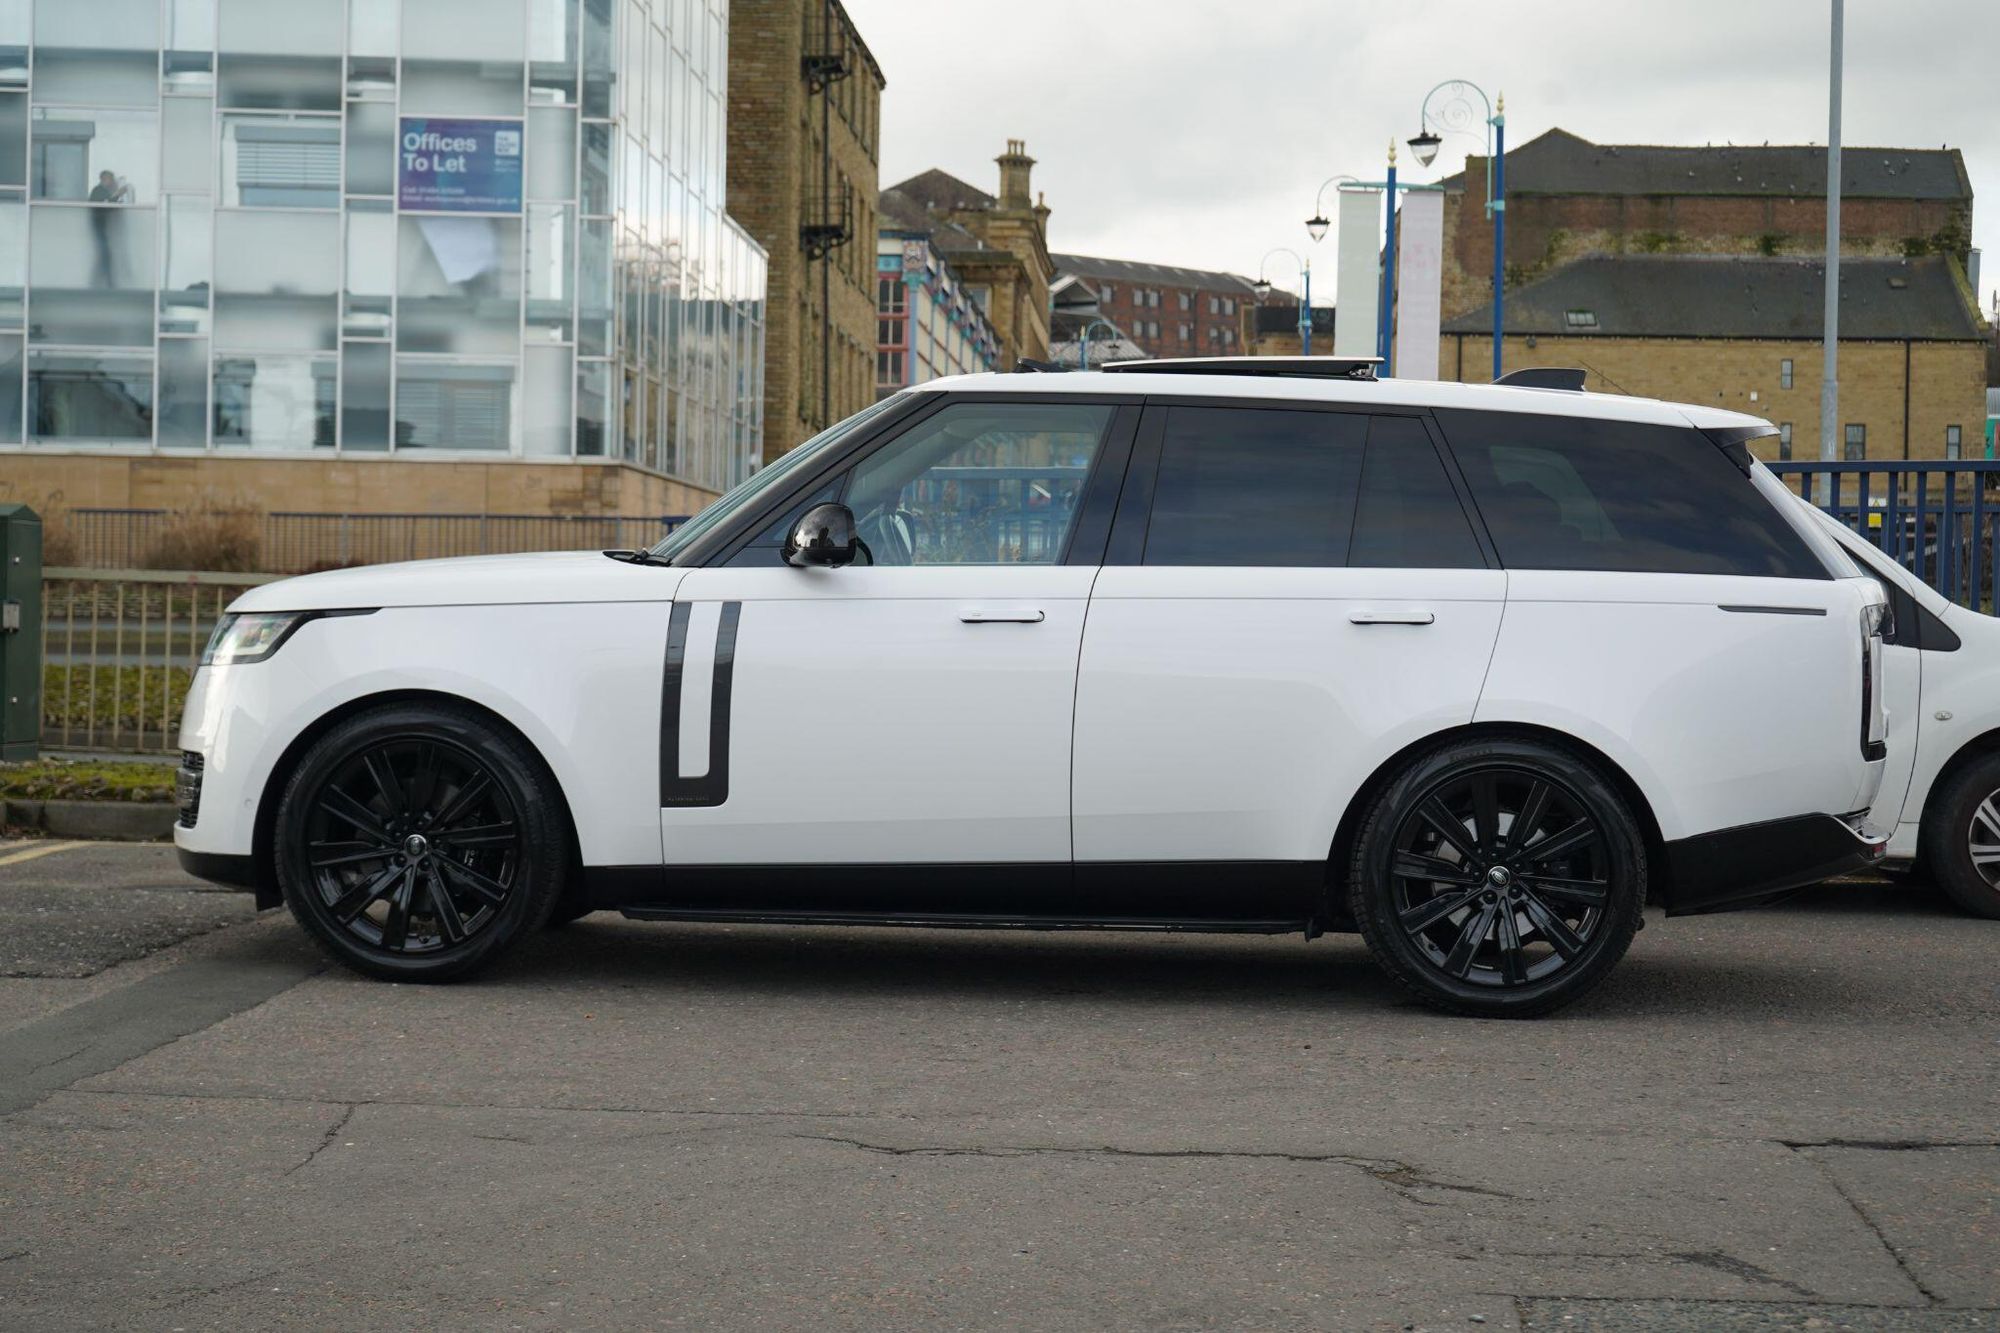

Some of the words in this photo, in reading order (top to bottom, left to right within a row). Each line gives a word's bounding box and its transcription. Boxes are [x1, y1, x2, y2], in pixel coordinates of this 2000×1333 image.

[403, 132, 477, 152] Offices
[403, 153, 428, 172] To
[433, 153, 467, 173] Let
